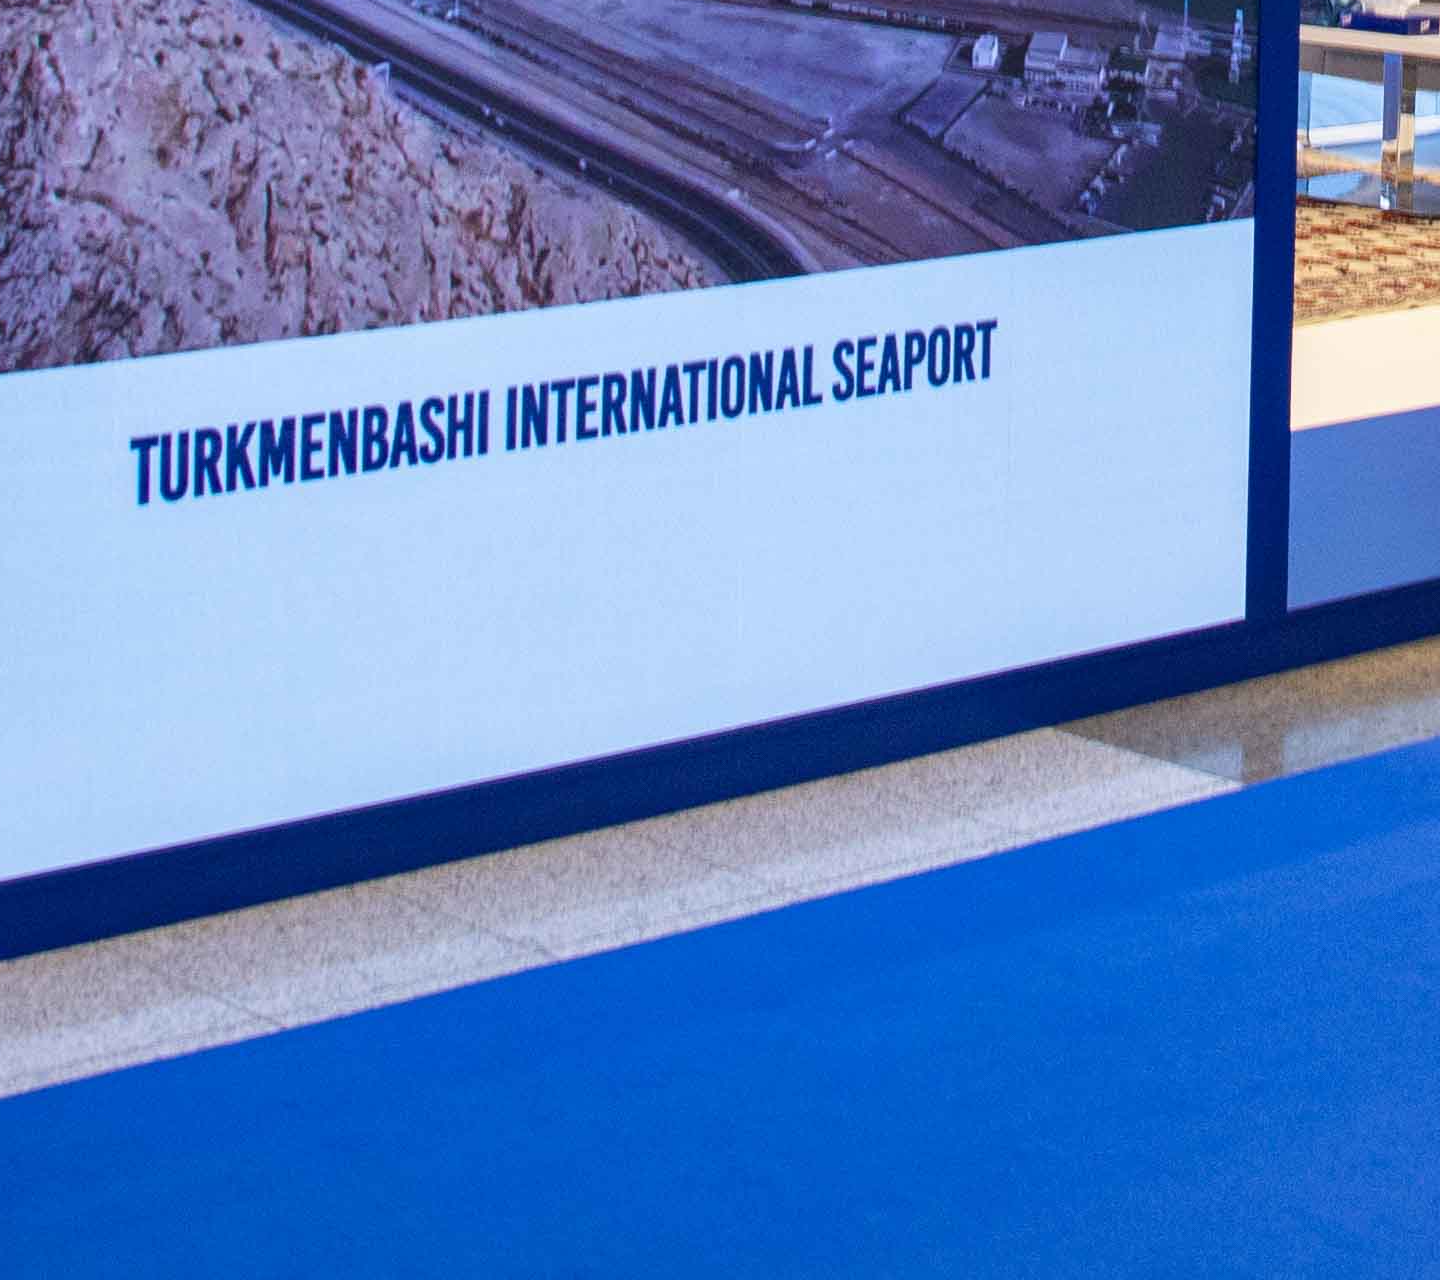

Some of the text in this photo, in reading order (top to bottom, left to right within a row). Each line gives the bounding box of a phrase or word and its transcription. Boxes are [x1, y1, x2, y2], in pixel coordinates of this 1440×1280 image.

[131, 319, 998, 506] TURKMENBASHI INTERNATIONAL SEAPORT
